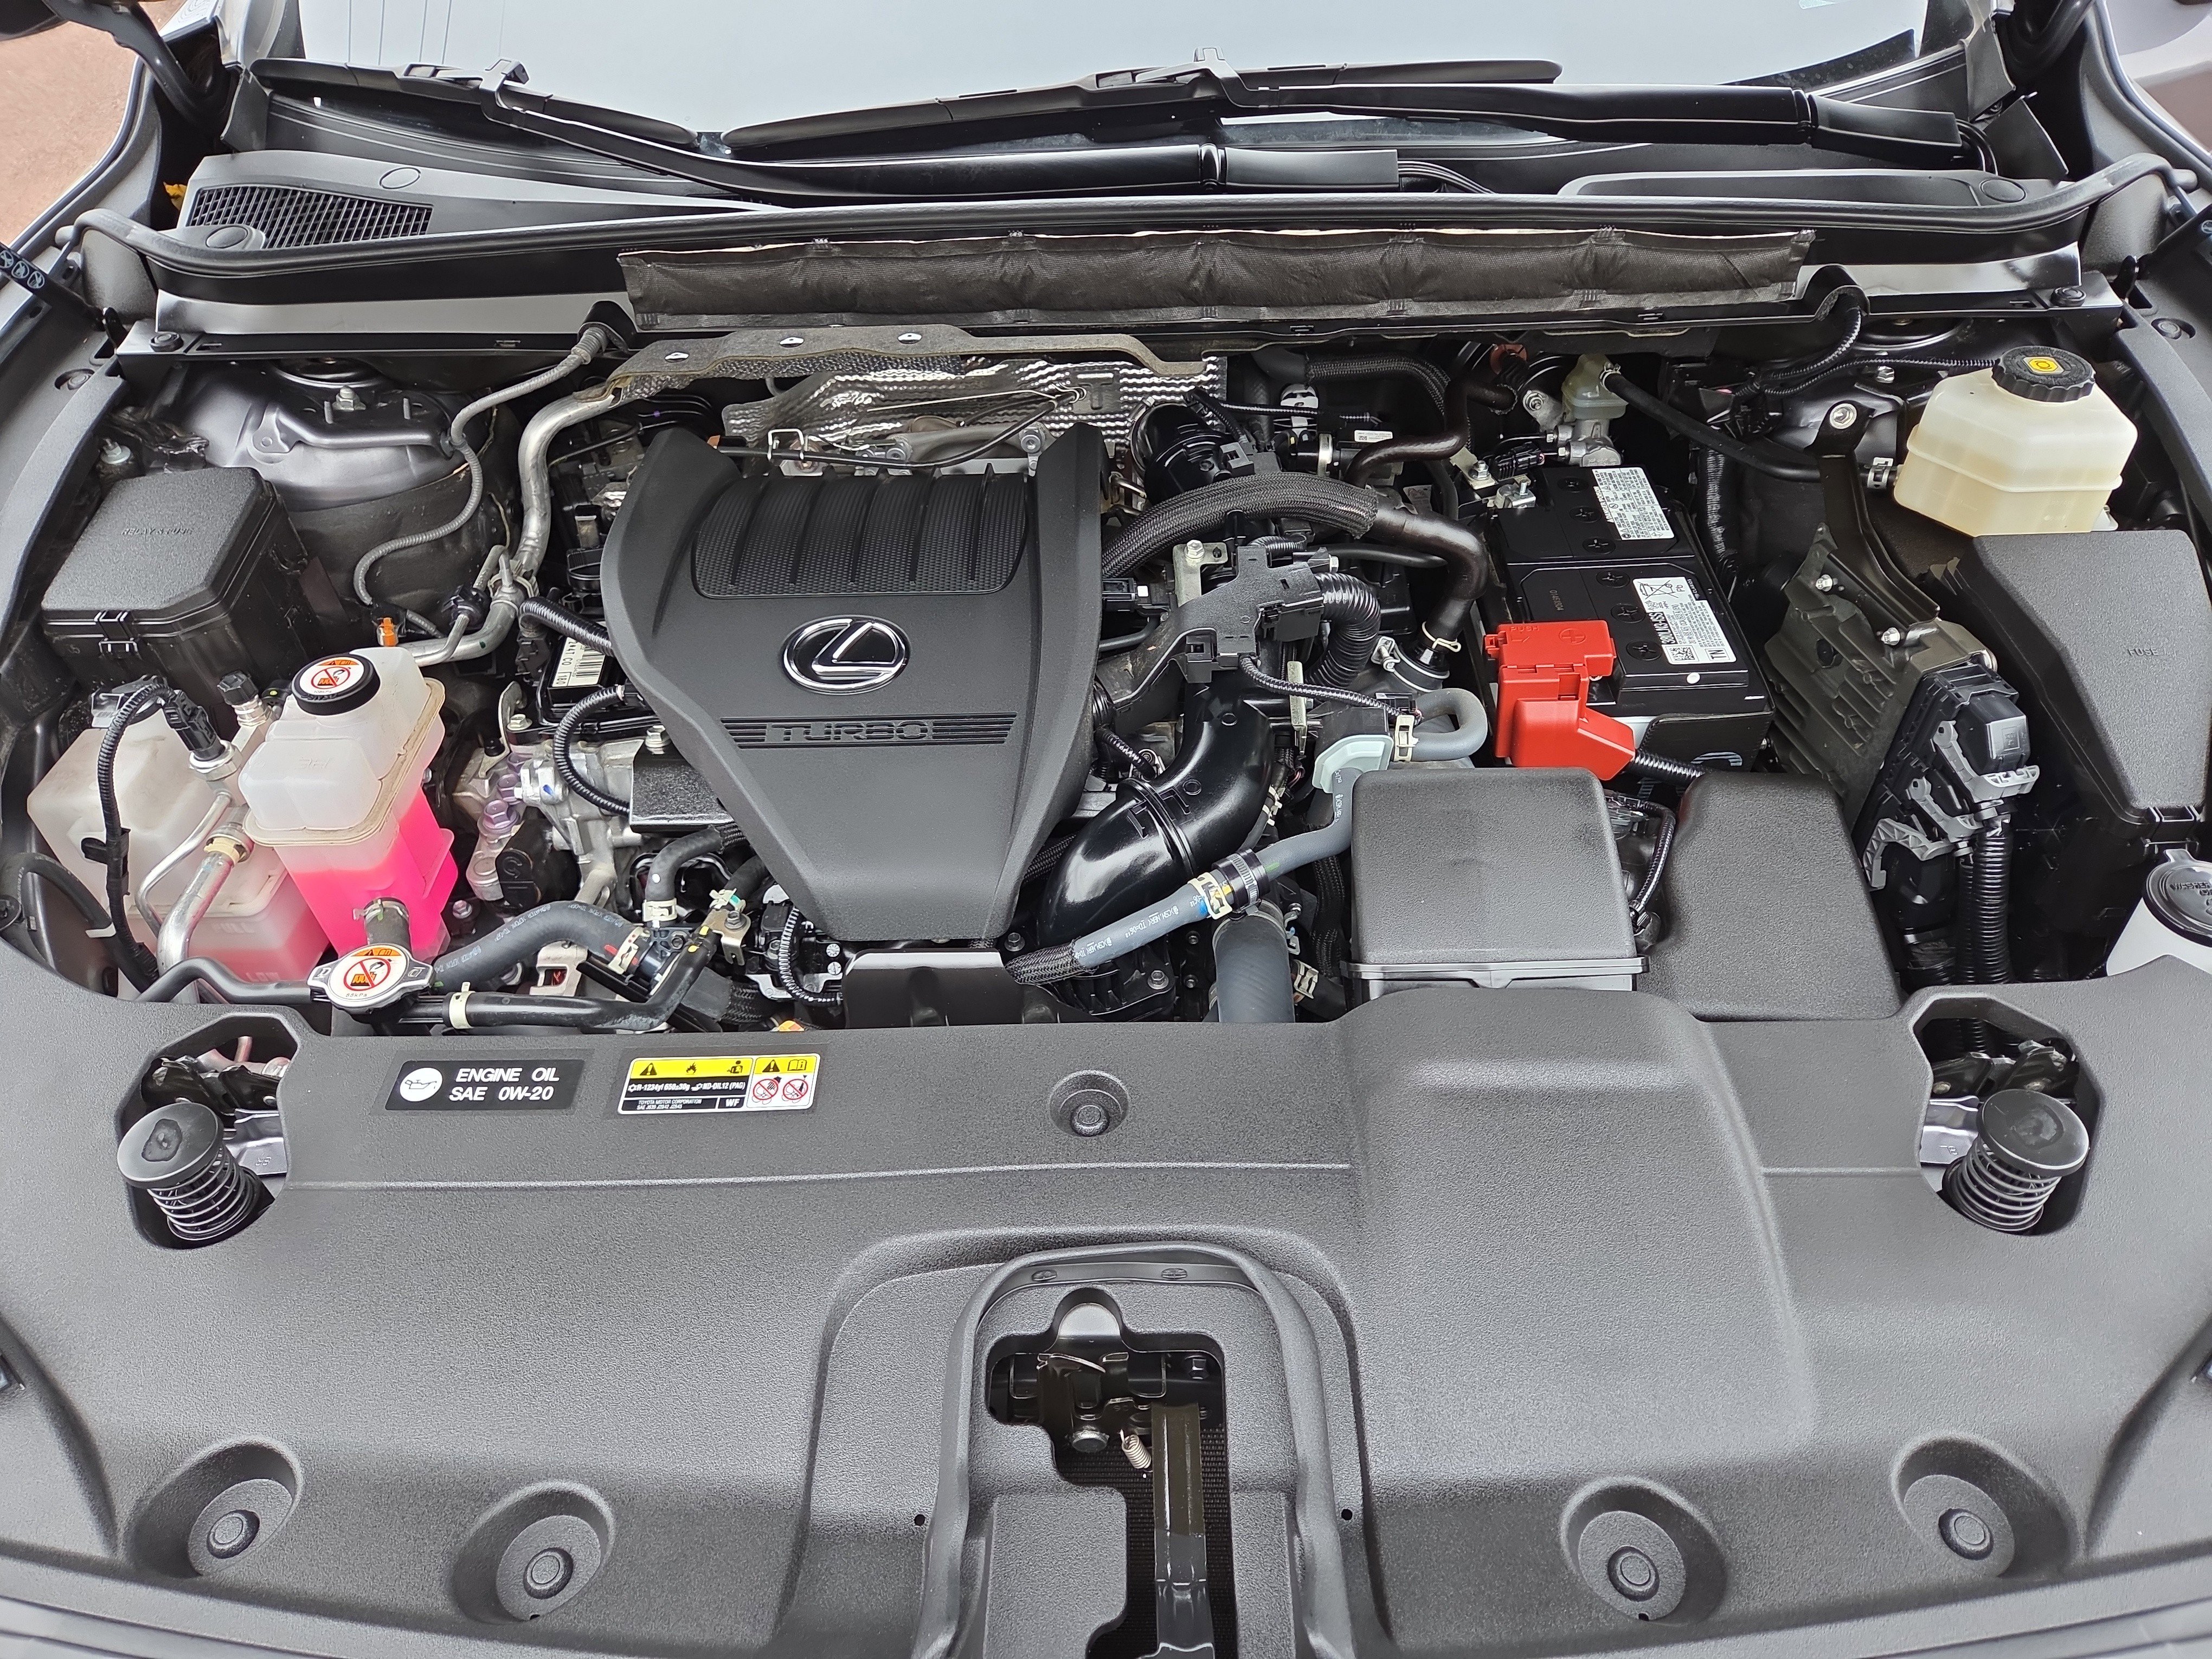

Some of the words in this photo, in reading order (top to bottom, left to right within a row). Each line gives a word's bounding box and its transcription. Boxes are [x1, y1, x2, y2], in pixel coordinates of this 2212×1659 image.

[1676, 584, 1686, 592] Pb
[1708, 650, 1728, 660] TN
[2127, 647, 2159, 657] FUSE
[771, 721, 929, 741] TURBO
[455, 1068, 523, 1082] ENGINE
[531, 1067, 560, 1082] OIL
[449, 1086, 488, 1101] SAE
[498, 1086, 554, 1101] 0W-20
[725, 1098, 740, 1107] WF
